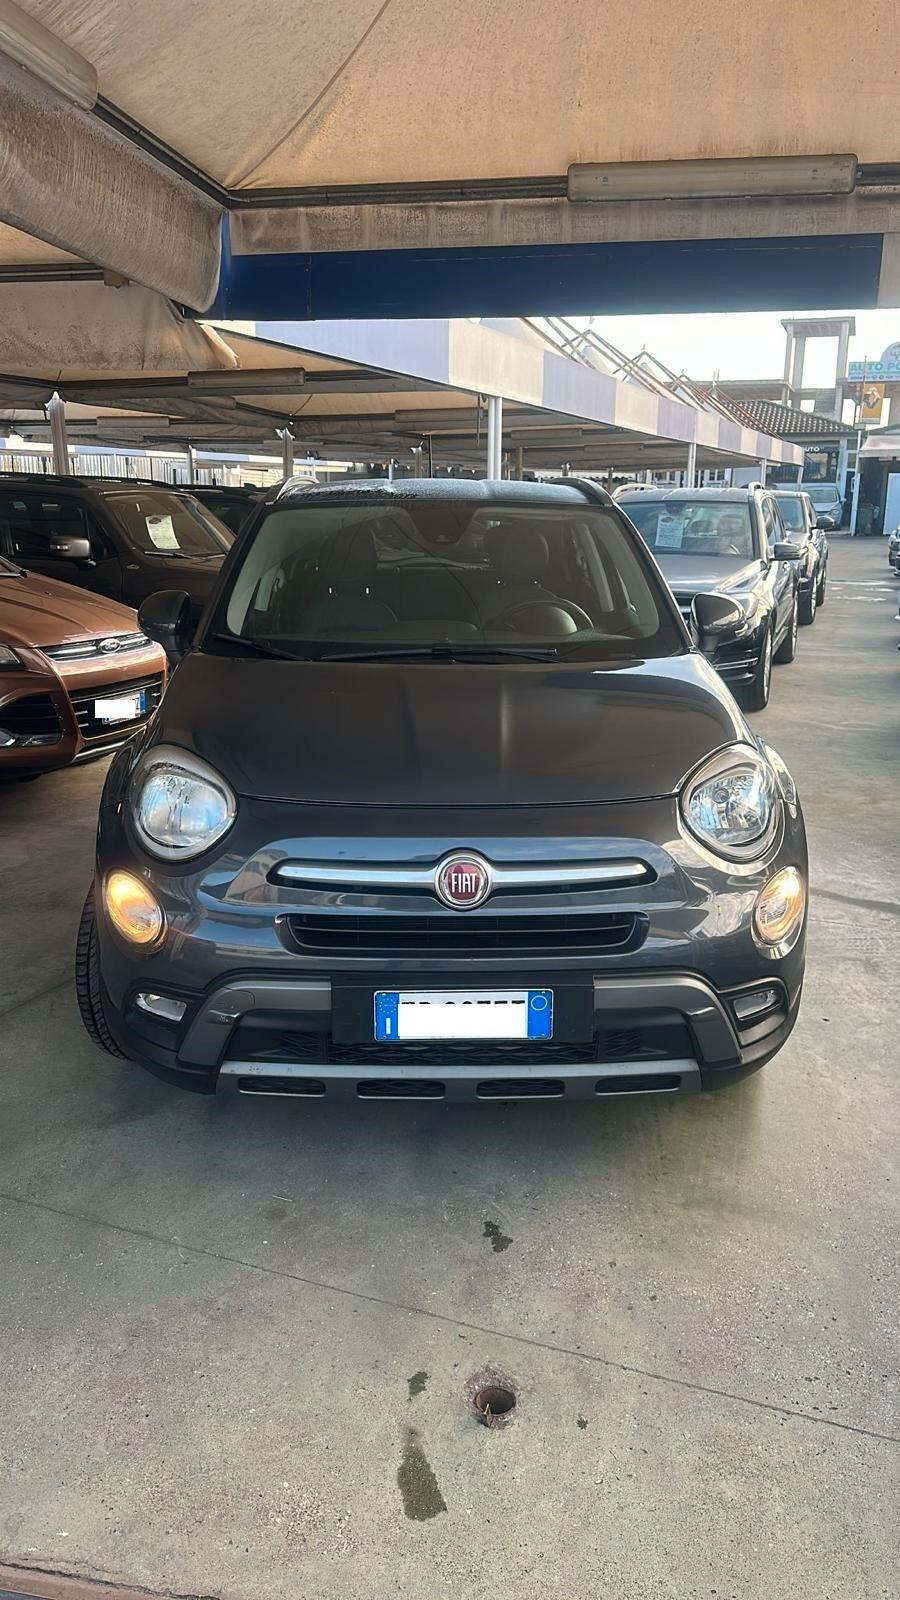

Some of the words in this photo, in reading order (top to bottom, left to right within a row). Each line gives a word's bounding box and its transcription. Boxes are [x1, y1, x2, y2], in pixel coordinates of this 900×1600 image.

[850, 363, 883, 371] AUTO
[451, 873, 477, 893] FIAT
[385, 1017, 391, 1034] I
